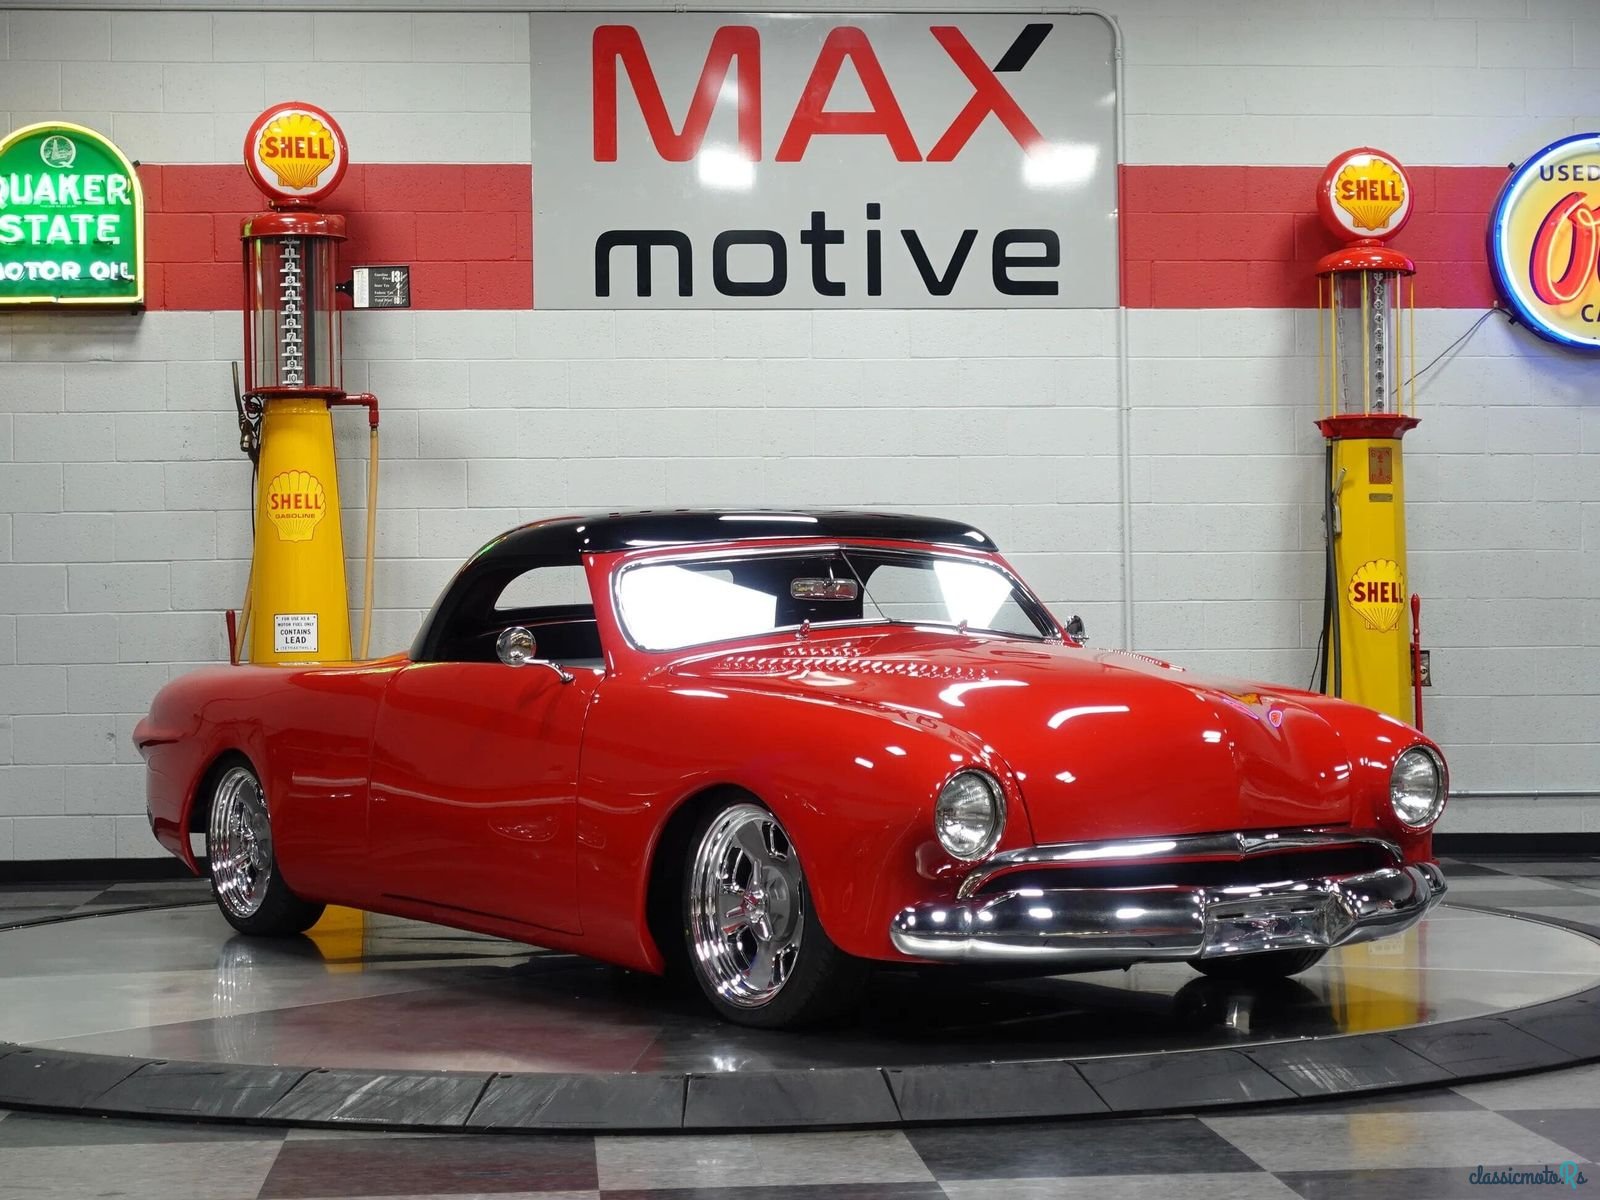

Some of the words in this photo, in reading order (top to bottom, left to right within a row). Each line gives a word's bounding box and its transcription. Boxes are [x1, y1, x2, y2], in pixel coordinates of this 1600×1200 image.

[592, 24, 1054, 162] MAX
[265, 136, 330, 160] SHELL
[1341, 178, 1401, 202] SHELL
[0, 214, 121, 245] STATE
[594, 202, 1061, 297] motive
[0, 261, 81, 281] OTOR
[90, 261, 134, 280] OIL
[271, 493, 321, 510] SHELL
[1353, 581, 1403, 603] SHELL
[285, 636, 307, 644] LEAD
